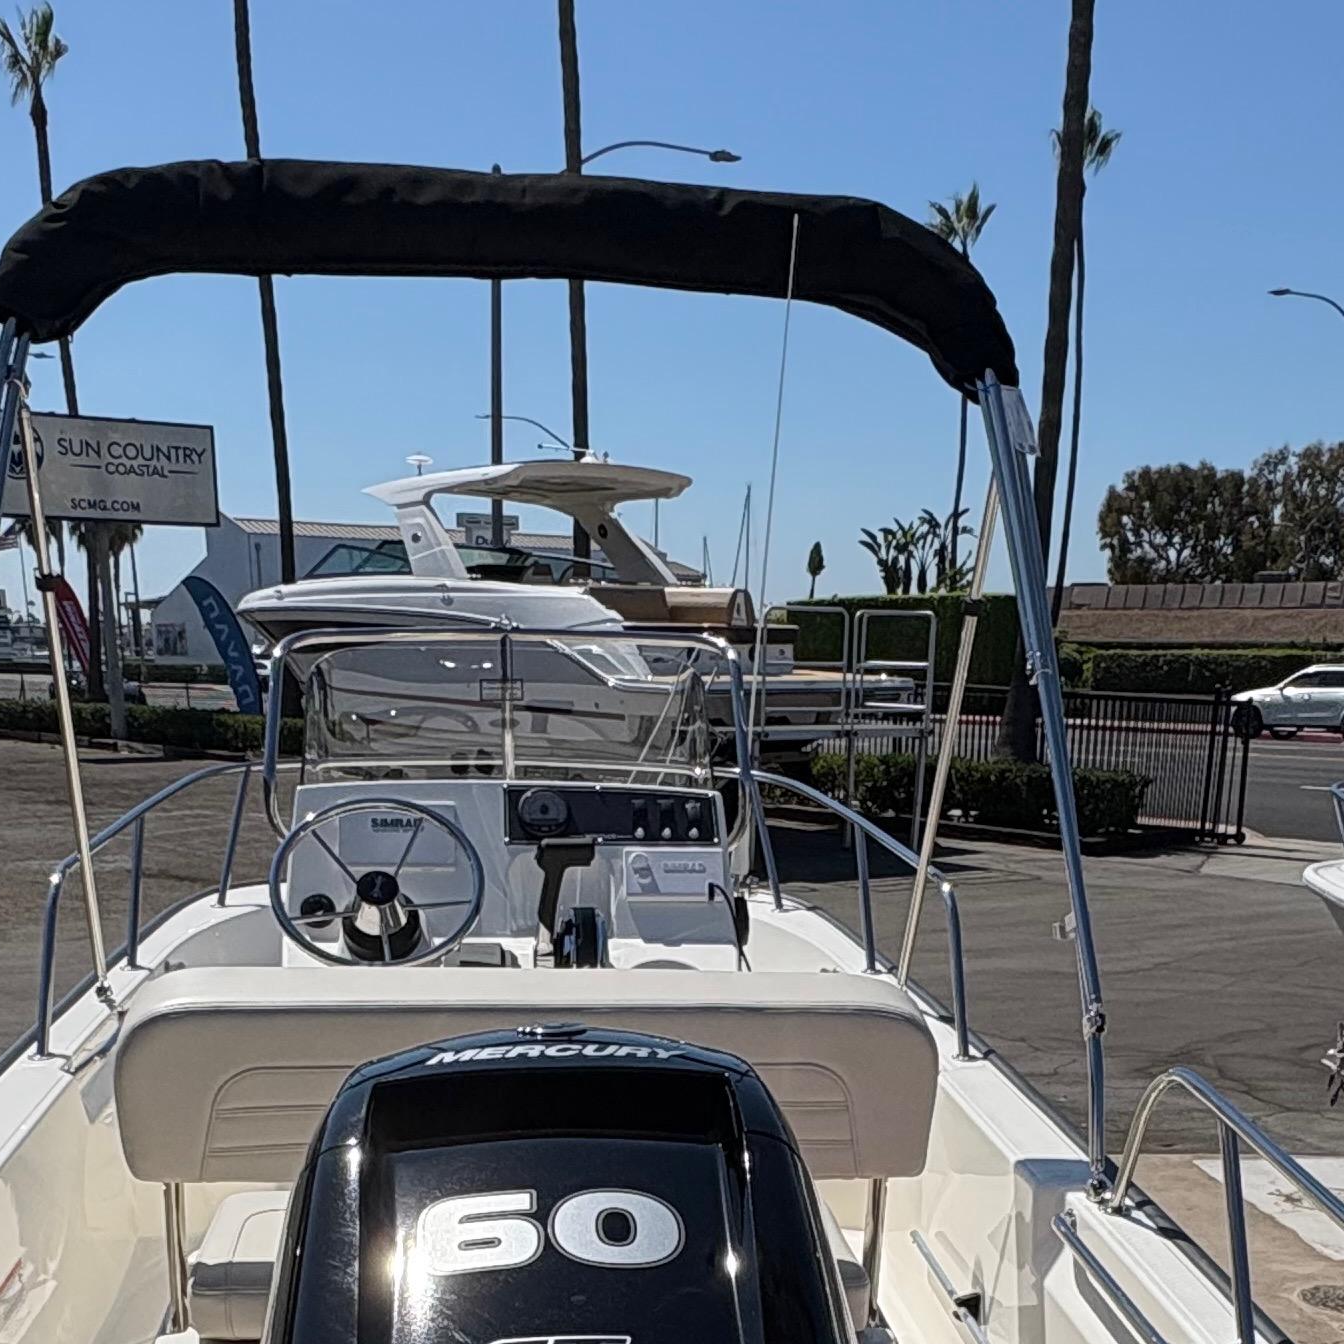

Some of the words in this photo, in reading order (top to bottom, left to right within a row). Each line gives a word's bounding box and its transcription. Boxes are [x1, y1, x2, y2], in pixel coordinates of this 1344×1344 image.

[57, 437, 102, 459] SUN
[107, 441, 206, 465] COUNTRY
[105, 462, 169, 479] COASTAL
[70, 498, 142, 513] SCMG.COM
[425, 1043, 689, 1067] MERCURY
[417, 1187, 687, 1277] 60
